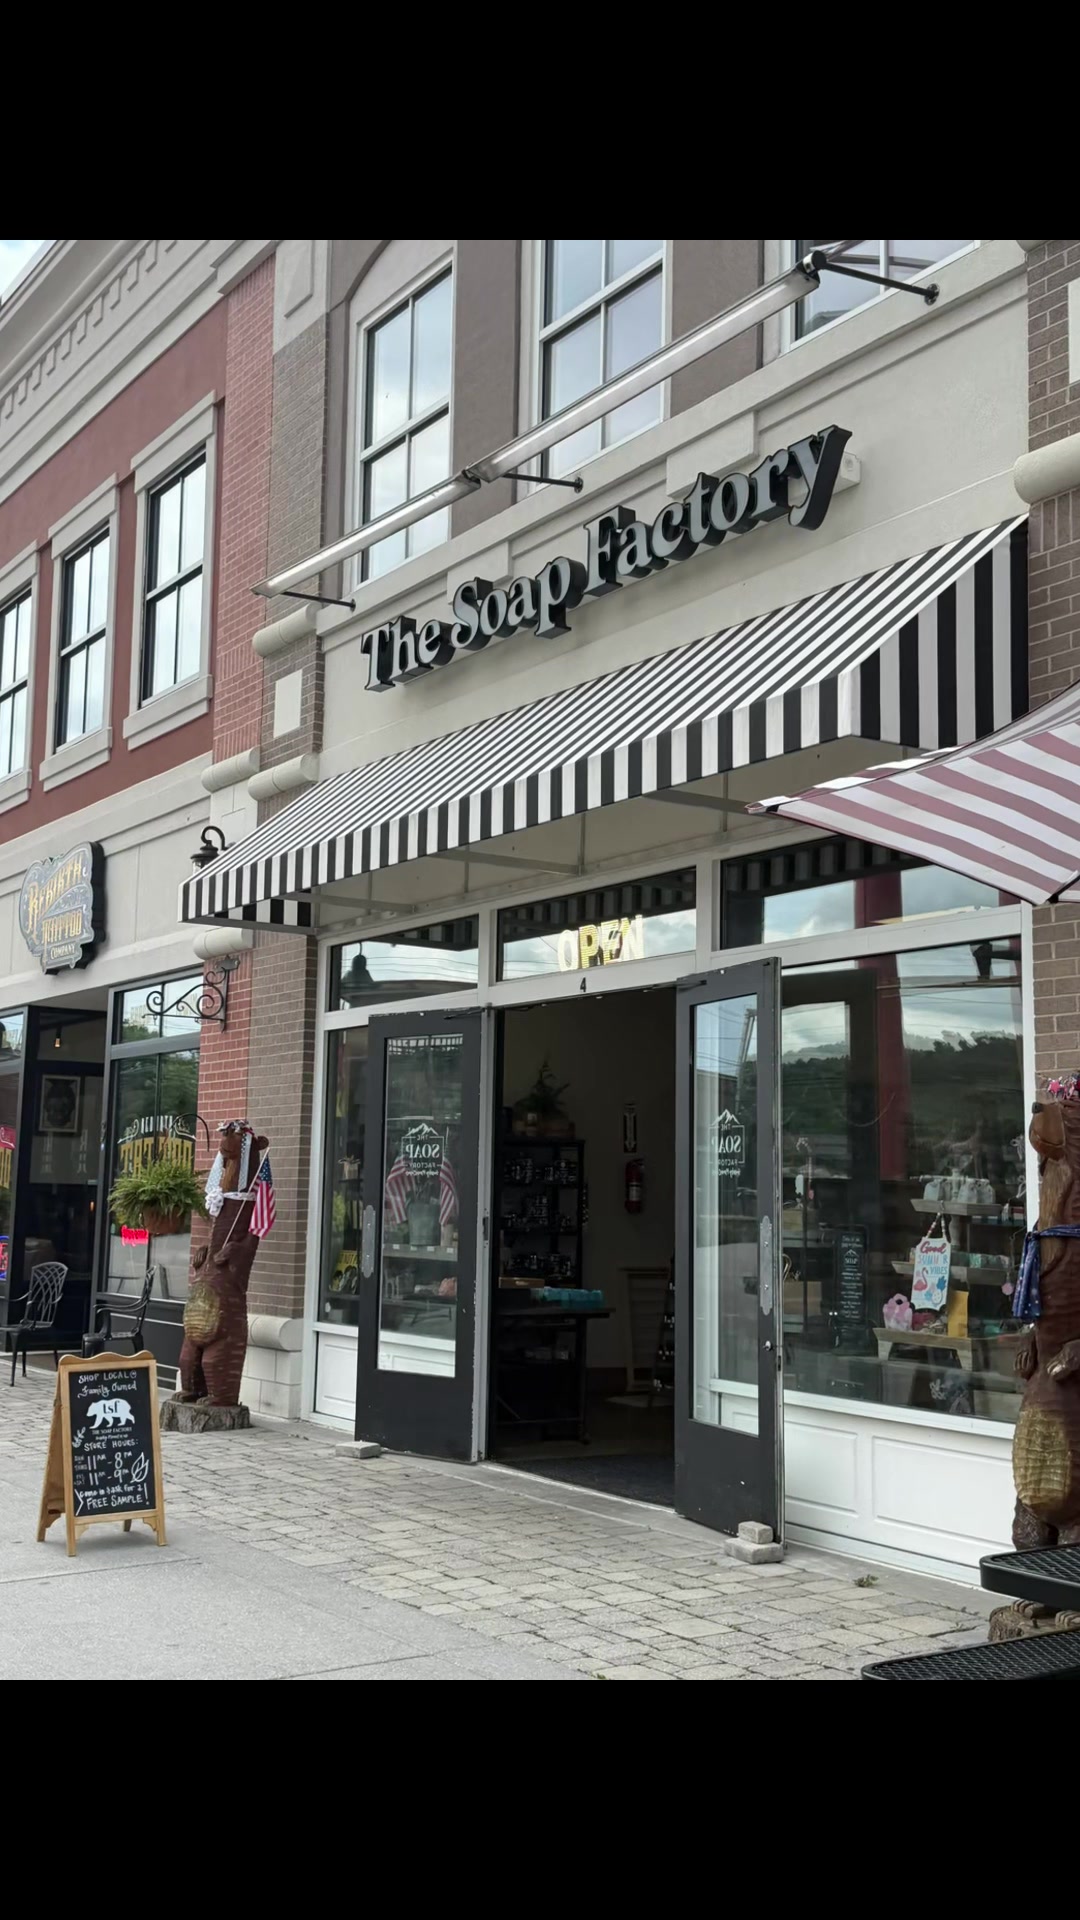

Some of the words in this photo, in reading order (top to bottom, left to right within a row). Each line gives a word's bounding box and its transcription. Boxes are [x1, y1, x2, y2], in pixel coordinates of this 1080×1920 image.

[361, 616, 455, 693] The
[450, 556, 587, 648] Soap
[584, 424, 853, 597] Factory
[558, 914, 645, 971] OPEN
[50, 943, 76, 960] COMPANY
[580, 977, 587, 993] 4
[920, 1241, 947, 1254] Good
[917, 1254, 949, 1265] SUMMR
[930, 1266, 948, 1275] VIBES
[78, 1373, 99, 1384] SHOP
[103, 1370, 129, 1381] LOCAL
[77, 1385, 110, 1398] Family
[111, 1380, 138, 1392] Owned
[103, 1401, 120, 1415] tsf
[84, 1441, 107, 1452] STORE
[112, 1438, 138, 1449] HOURS:
[86, 1497, 109, 1511] FREE
